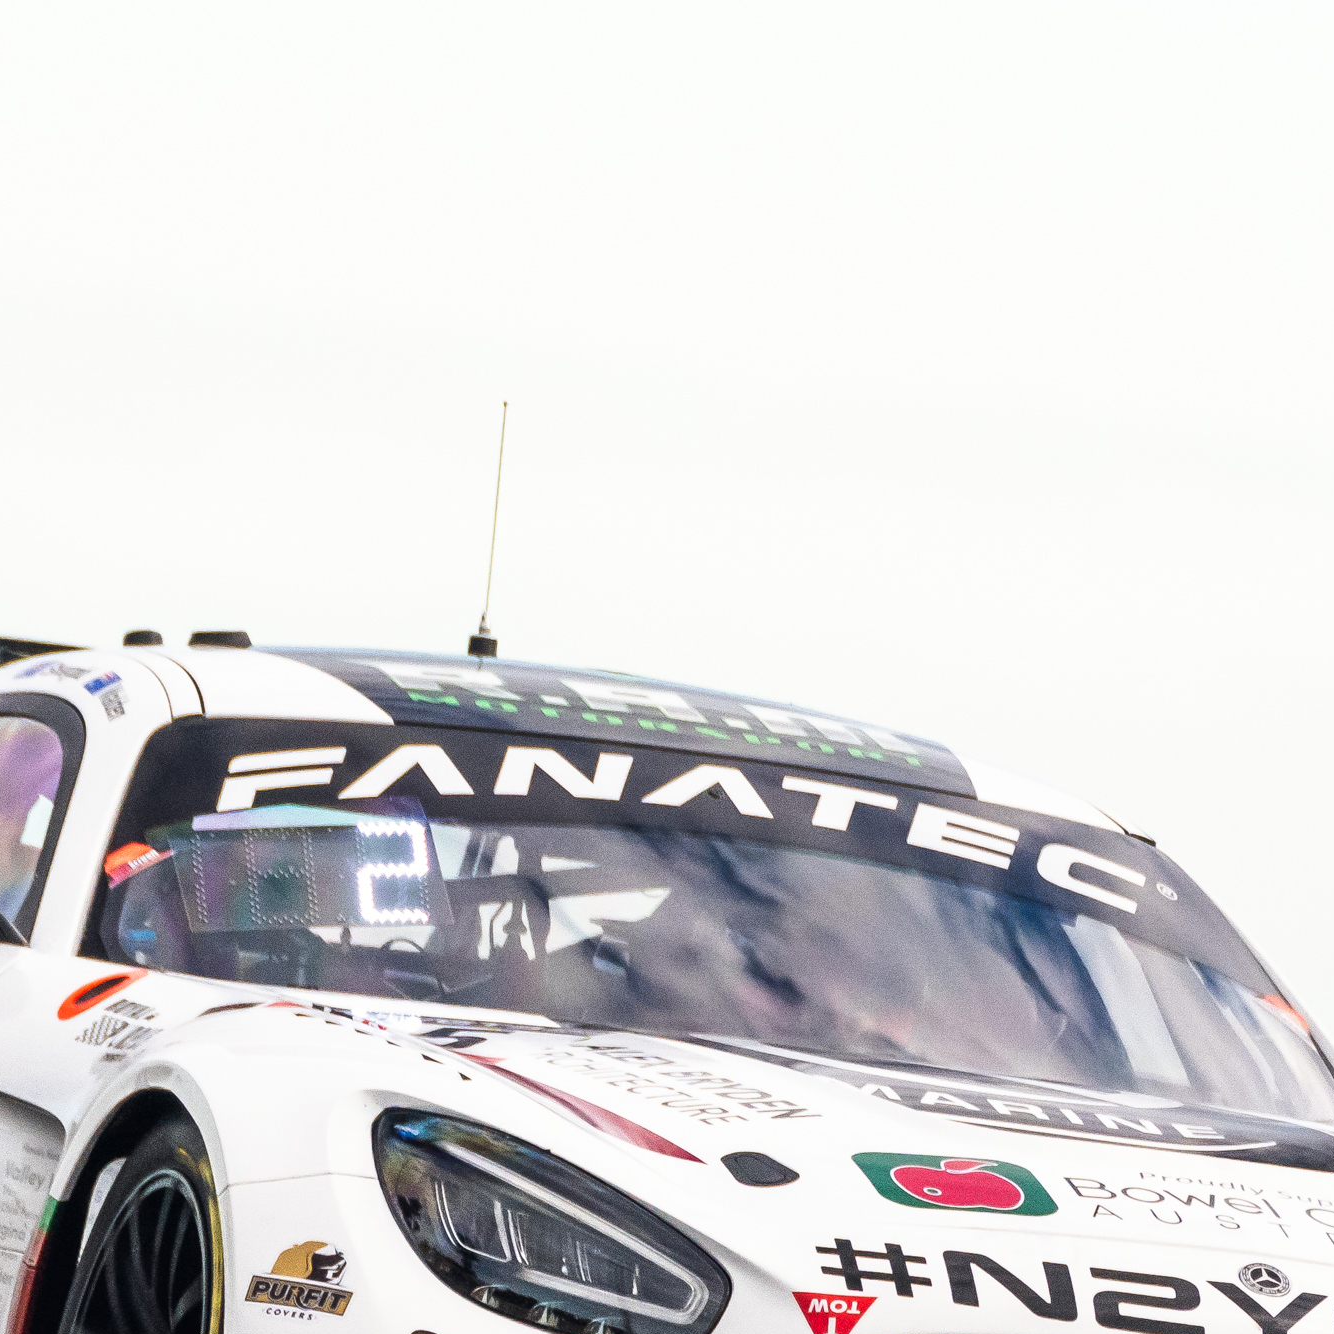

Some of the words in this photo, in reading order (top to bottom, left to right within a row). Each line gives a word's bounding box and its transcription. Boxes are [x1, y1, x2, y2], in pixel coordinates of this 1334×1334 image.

[216, 744, 1146, 914] FANATEC
[529, 1046, 750, 1126] RCHITECTURE
[1063, 1176, 1282, 1219] Bowel
[1138, 1171, 1265, 1196] Proudly
[250, 1280, 348, 1311] PURFIT
[808, 1298, 861, 1315] TOW
[265, 1307, 314, 1321] COVERS
